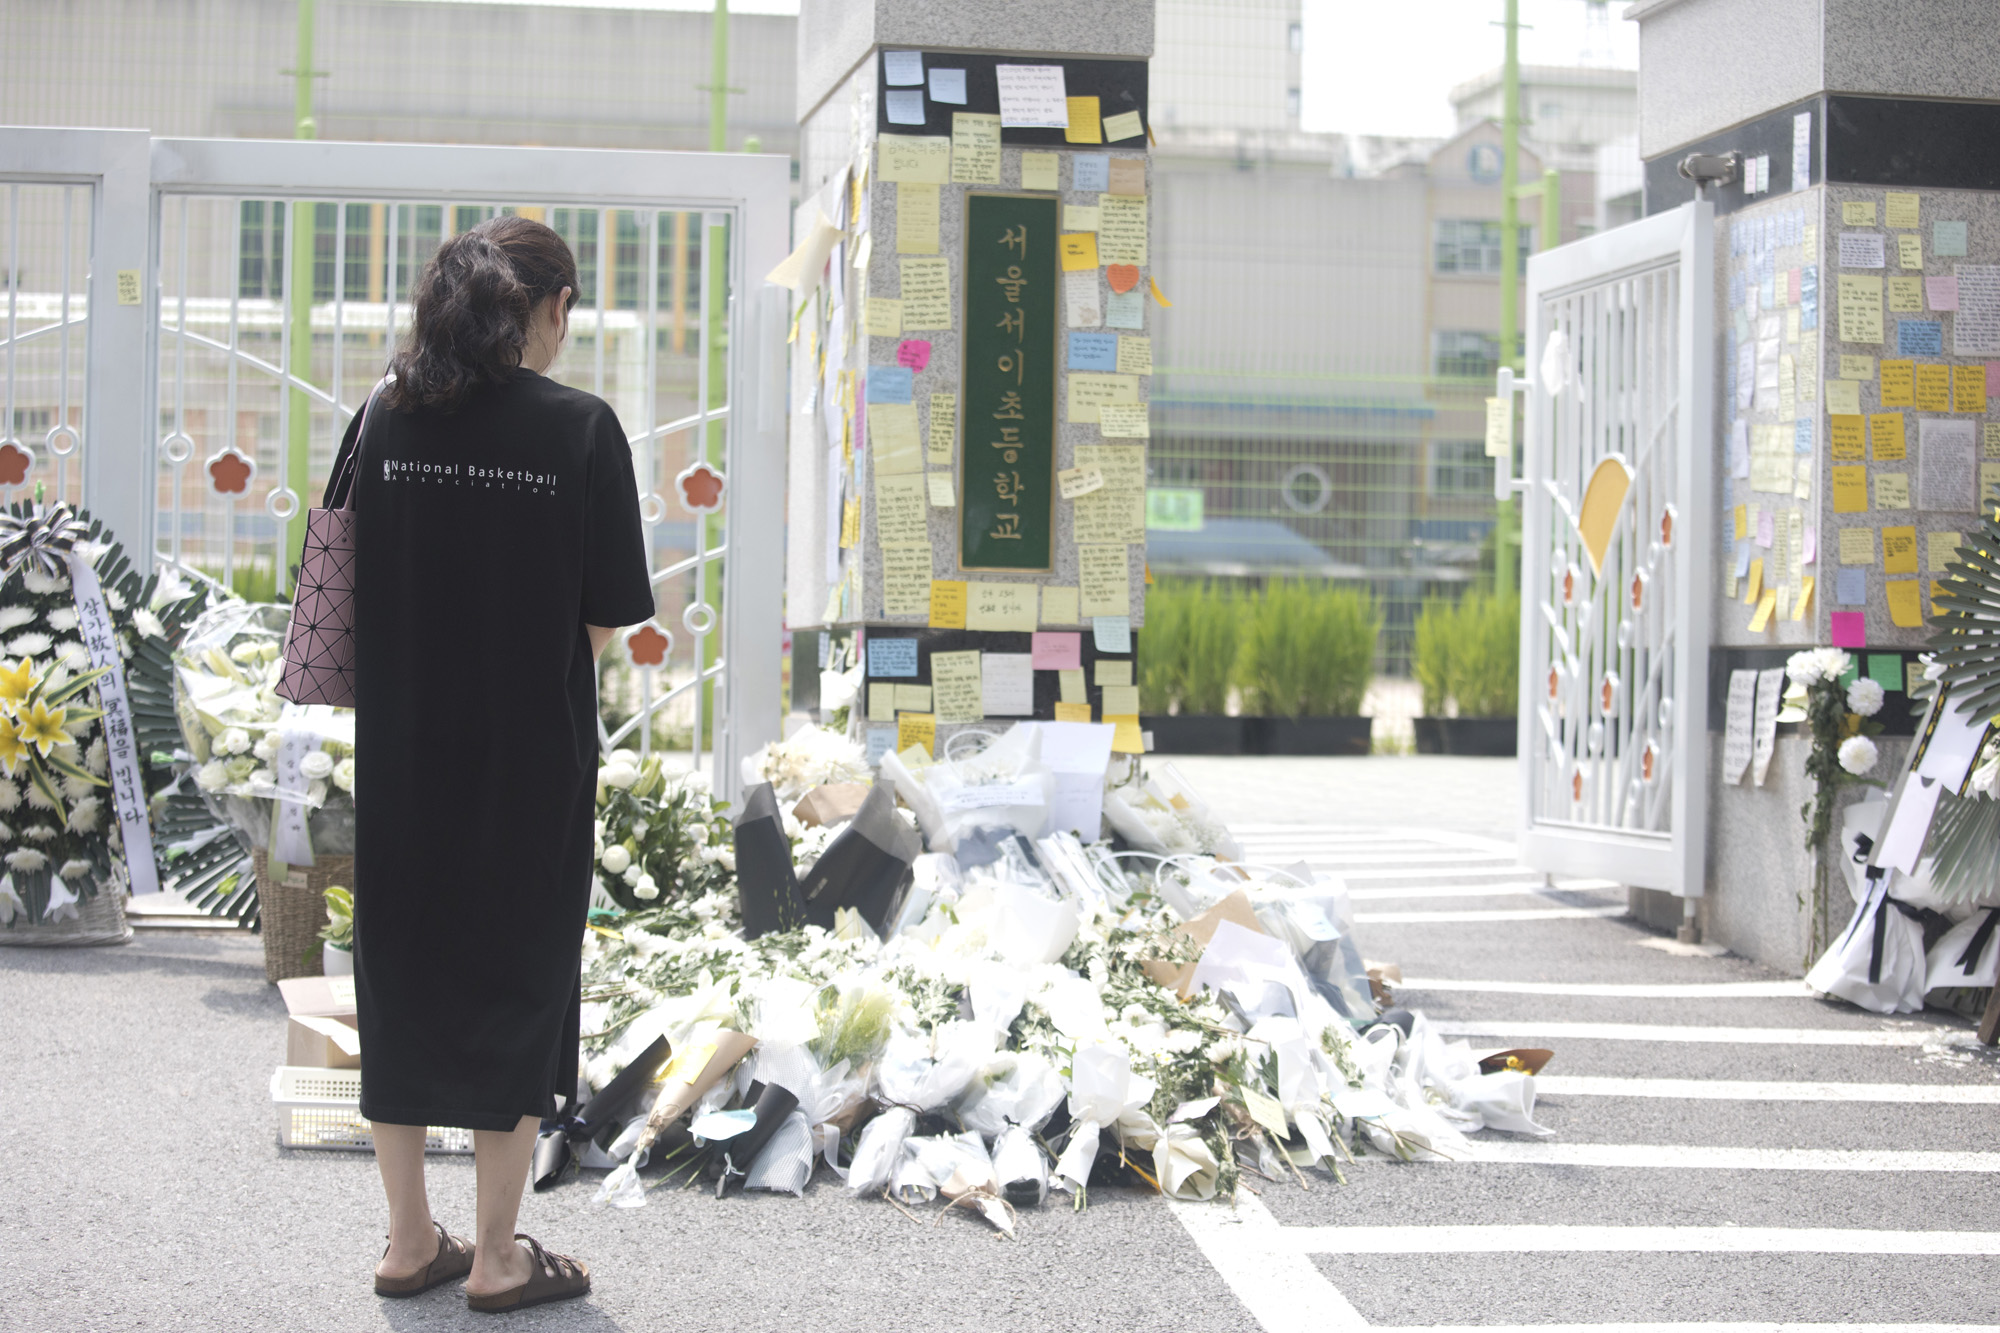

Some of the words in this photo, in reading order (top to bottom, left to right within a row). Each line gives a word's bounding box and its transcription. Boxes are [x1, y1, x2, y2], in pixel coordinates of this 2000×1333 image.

[990, 224, 1028, 540] 서울서이초등학교
[391, 460, 458, 475] National
[468, 465, 557, 486] Basketball
[392, 474, 556, 496] Association
[115, 766, 144, 826] 빕니다
